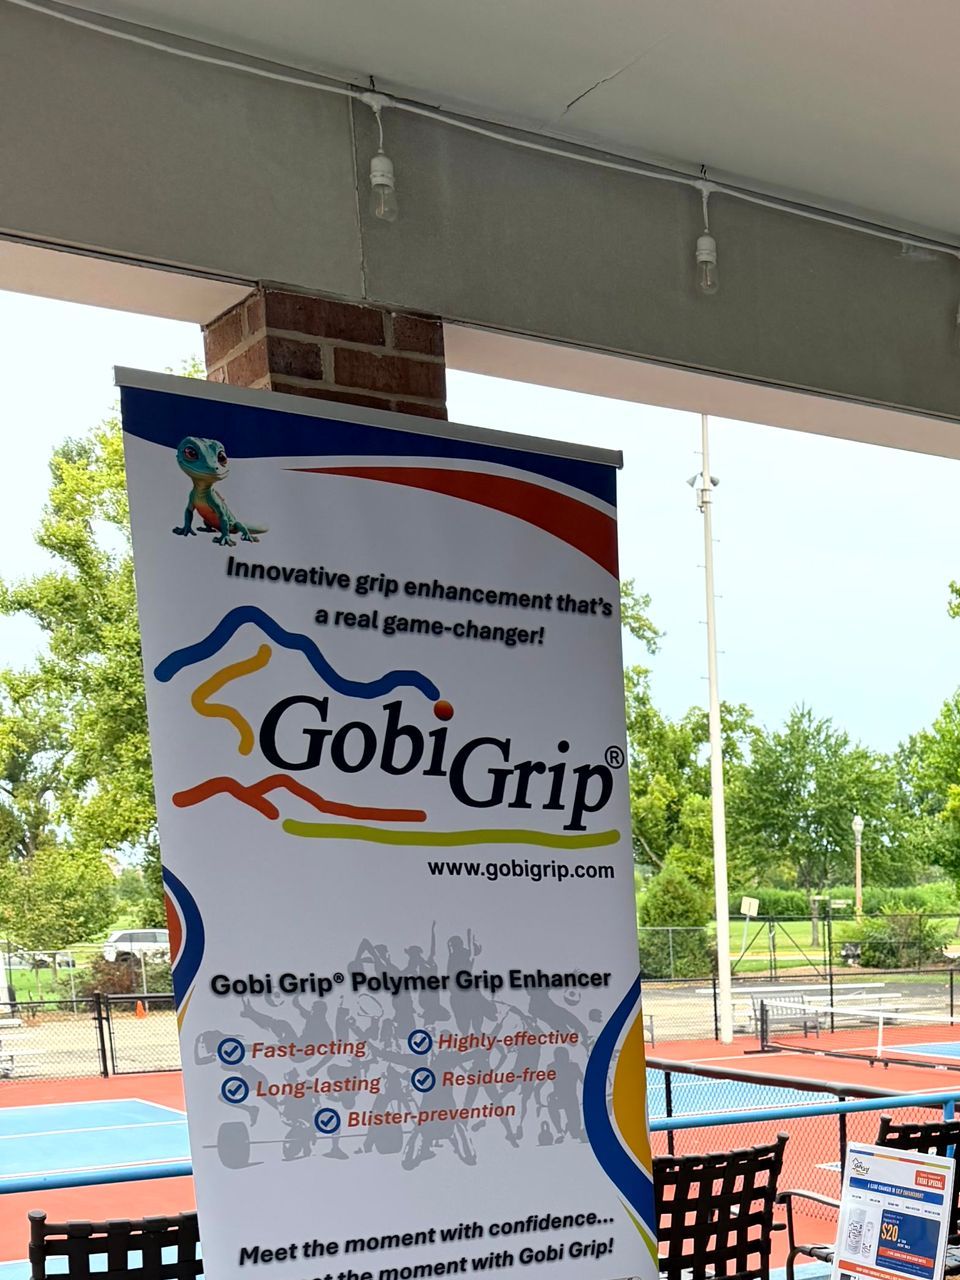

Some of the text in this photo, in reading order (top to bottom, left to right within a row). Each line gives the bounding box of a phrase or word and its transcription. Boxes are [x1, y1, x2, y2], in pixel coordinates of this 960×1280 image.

[226, 555, 613, 617] Innovative grip enhancement that's
[314, 607, 545, 647] a real game-changer!
[427, 858, 616, 884] www.gobigrip.com
[210, 969, 612, 998] Gobi Grip® Polymer Grip Enhancer
[251, 1038, 367, 1062] Fast-acting
[437, 1030, 580, 1052] Highly-effective
[255, 1076, 382, 1099] Long-lasting
[441, 1066, 557, 1088] Residue-free
[346, 1102, 517, 1129] Blister-prevention
[239, 1210, 615, 1266] Meet the moment with confidence...
[881, 1223, 899, 1242] $20
[471, 1251, 515, 1276] with
[518, 1243, 565, 1270] Gobi
[568, 1237, 615, 1260] Grip!
